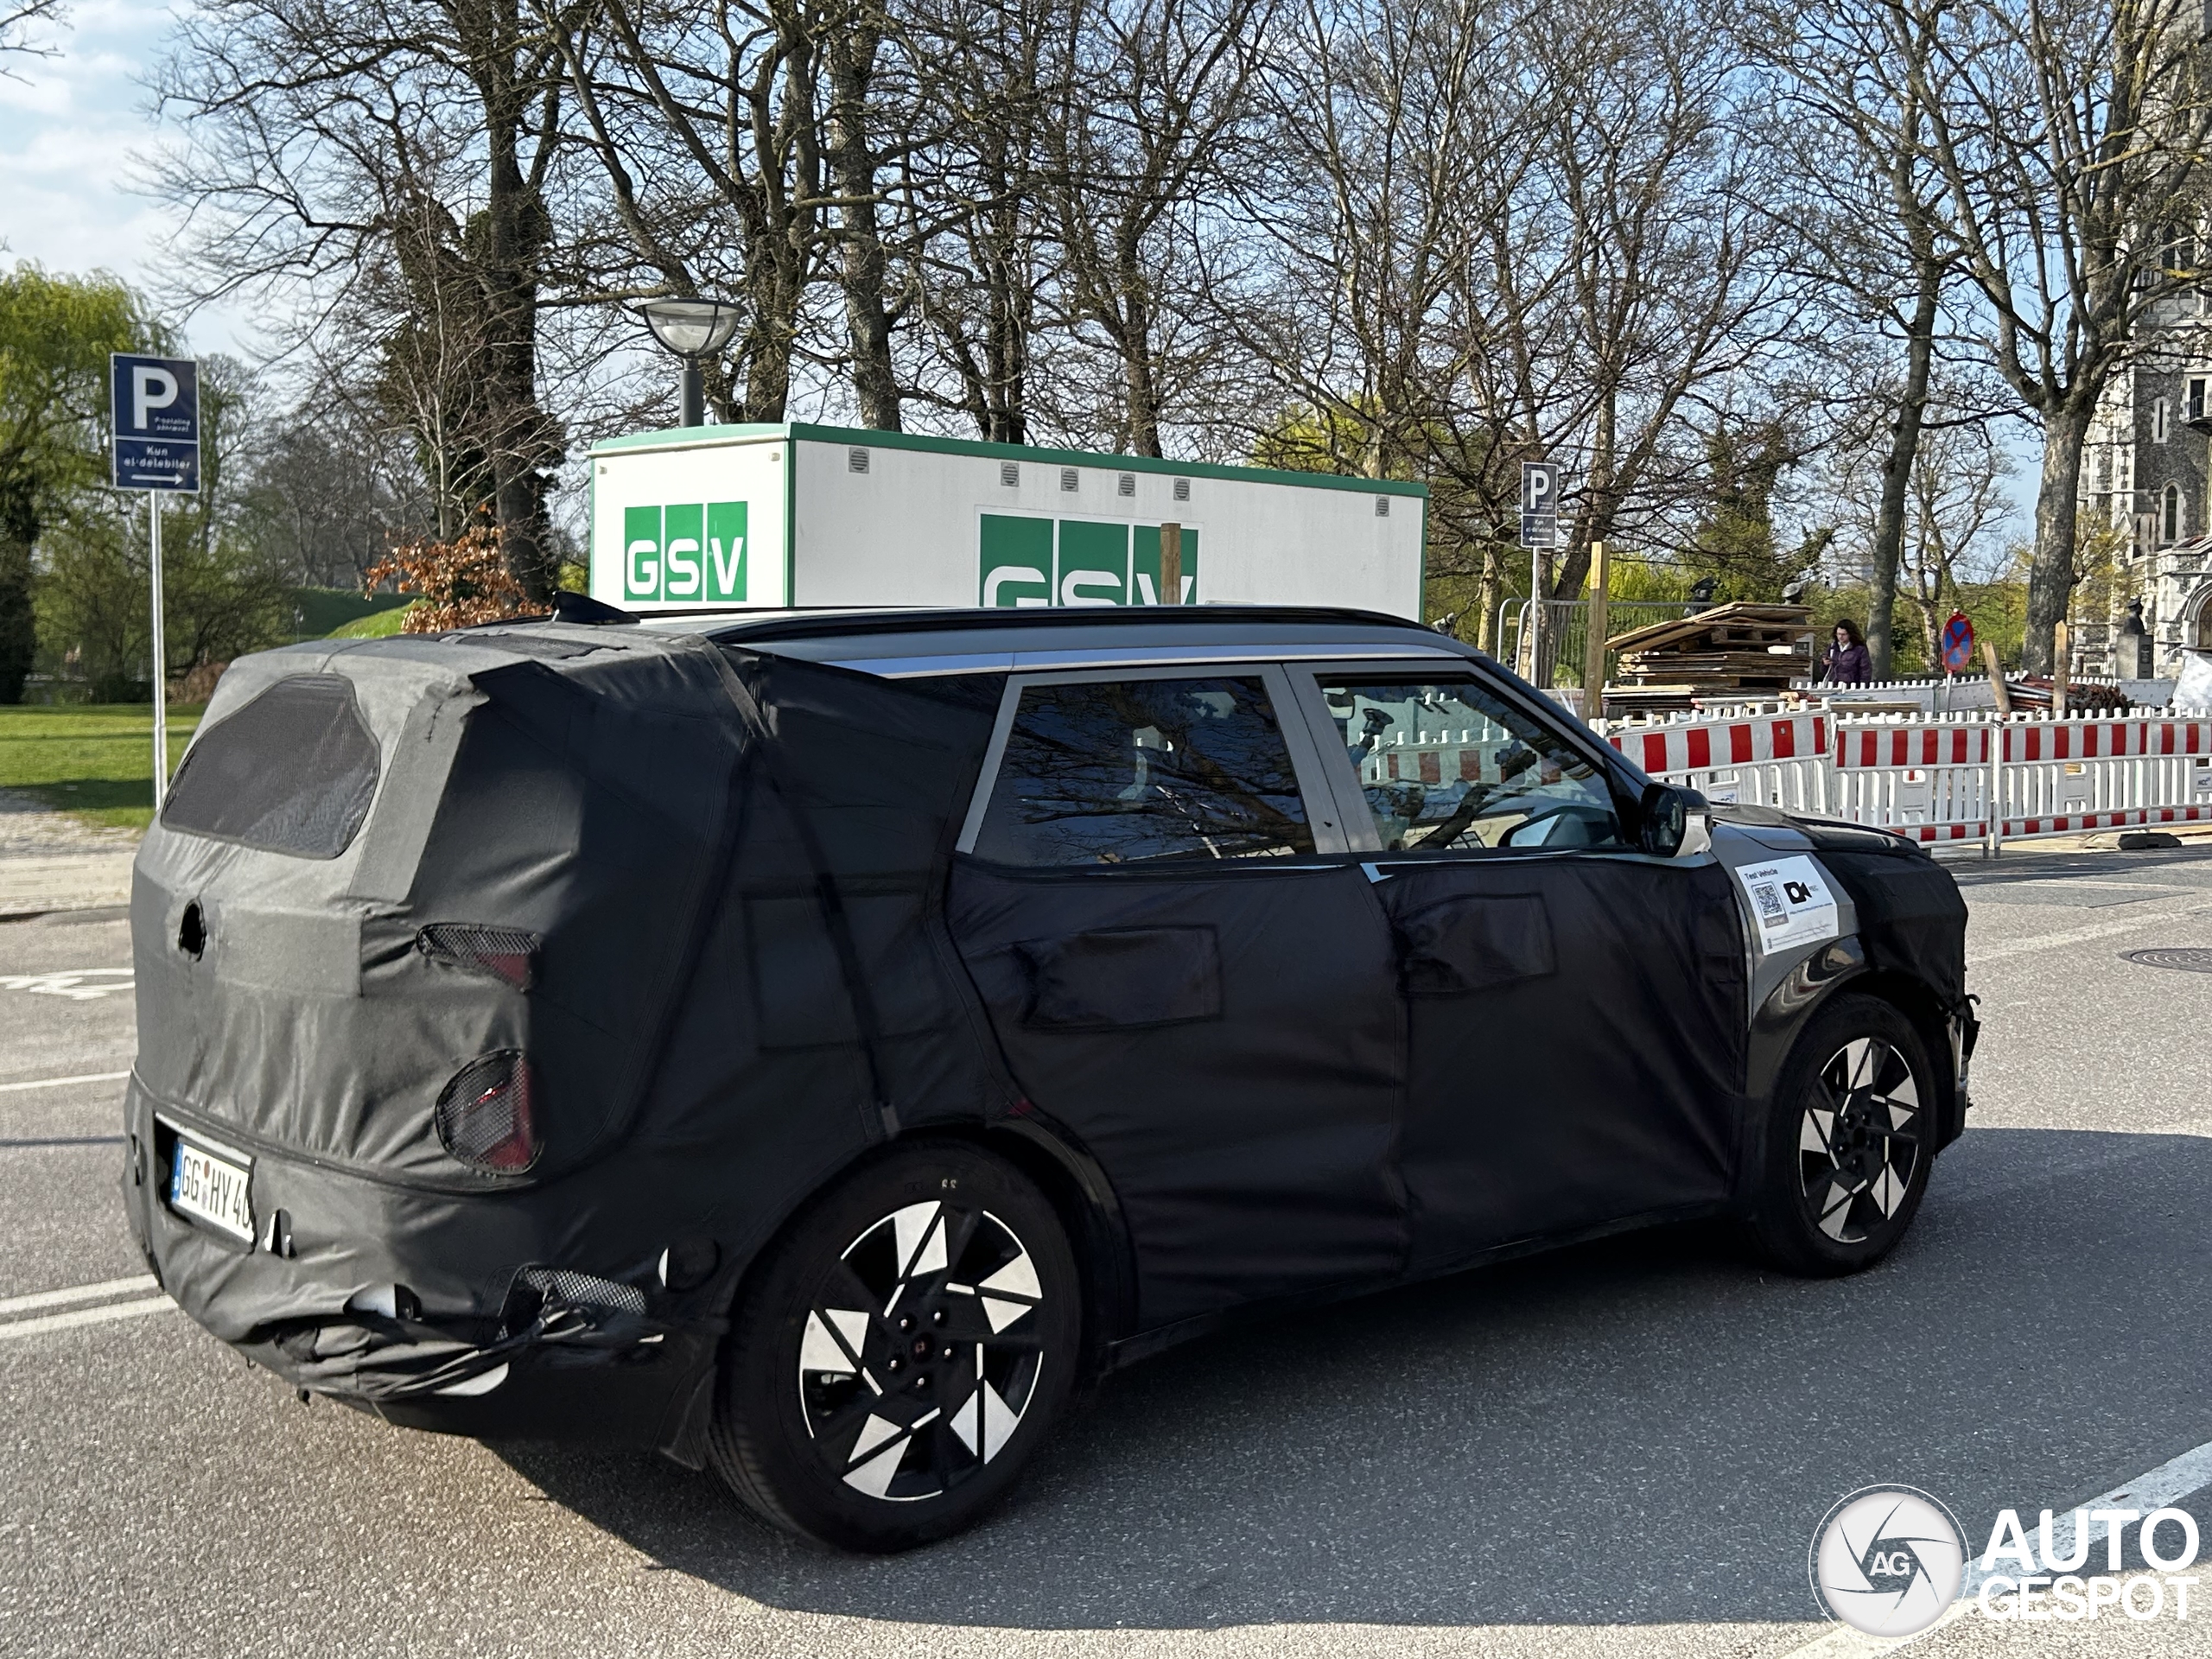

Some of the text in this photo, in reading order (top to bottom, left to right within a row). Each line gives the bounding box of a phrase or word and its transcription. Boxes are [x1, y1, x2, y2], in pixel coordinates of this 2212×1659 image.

[133, 365, 178, 429] P
[145, 445, 168, 456] Kun
[1530, 470, 1549, 509] P
[627, 537, 744, 594] GSV
[1744, 868, 1779, 880] Test Vehicle
[182, 1155, 200, 1202] GG
